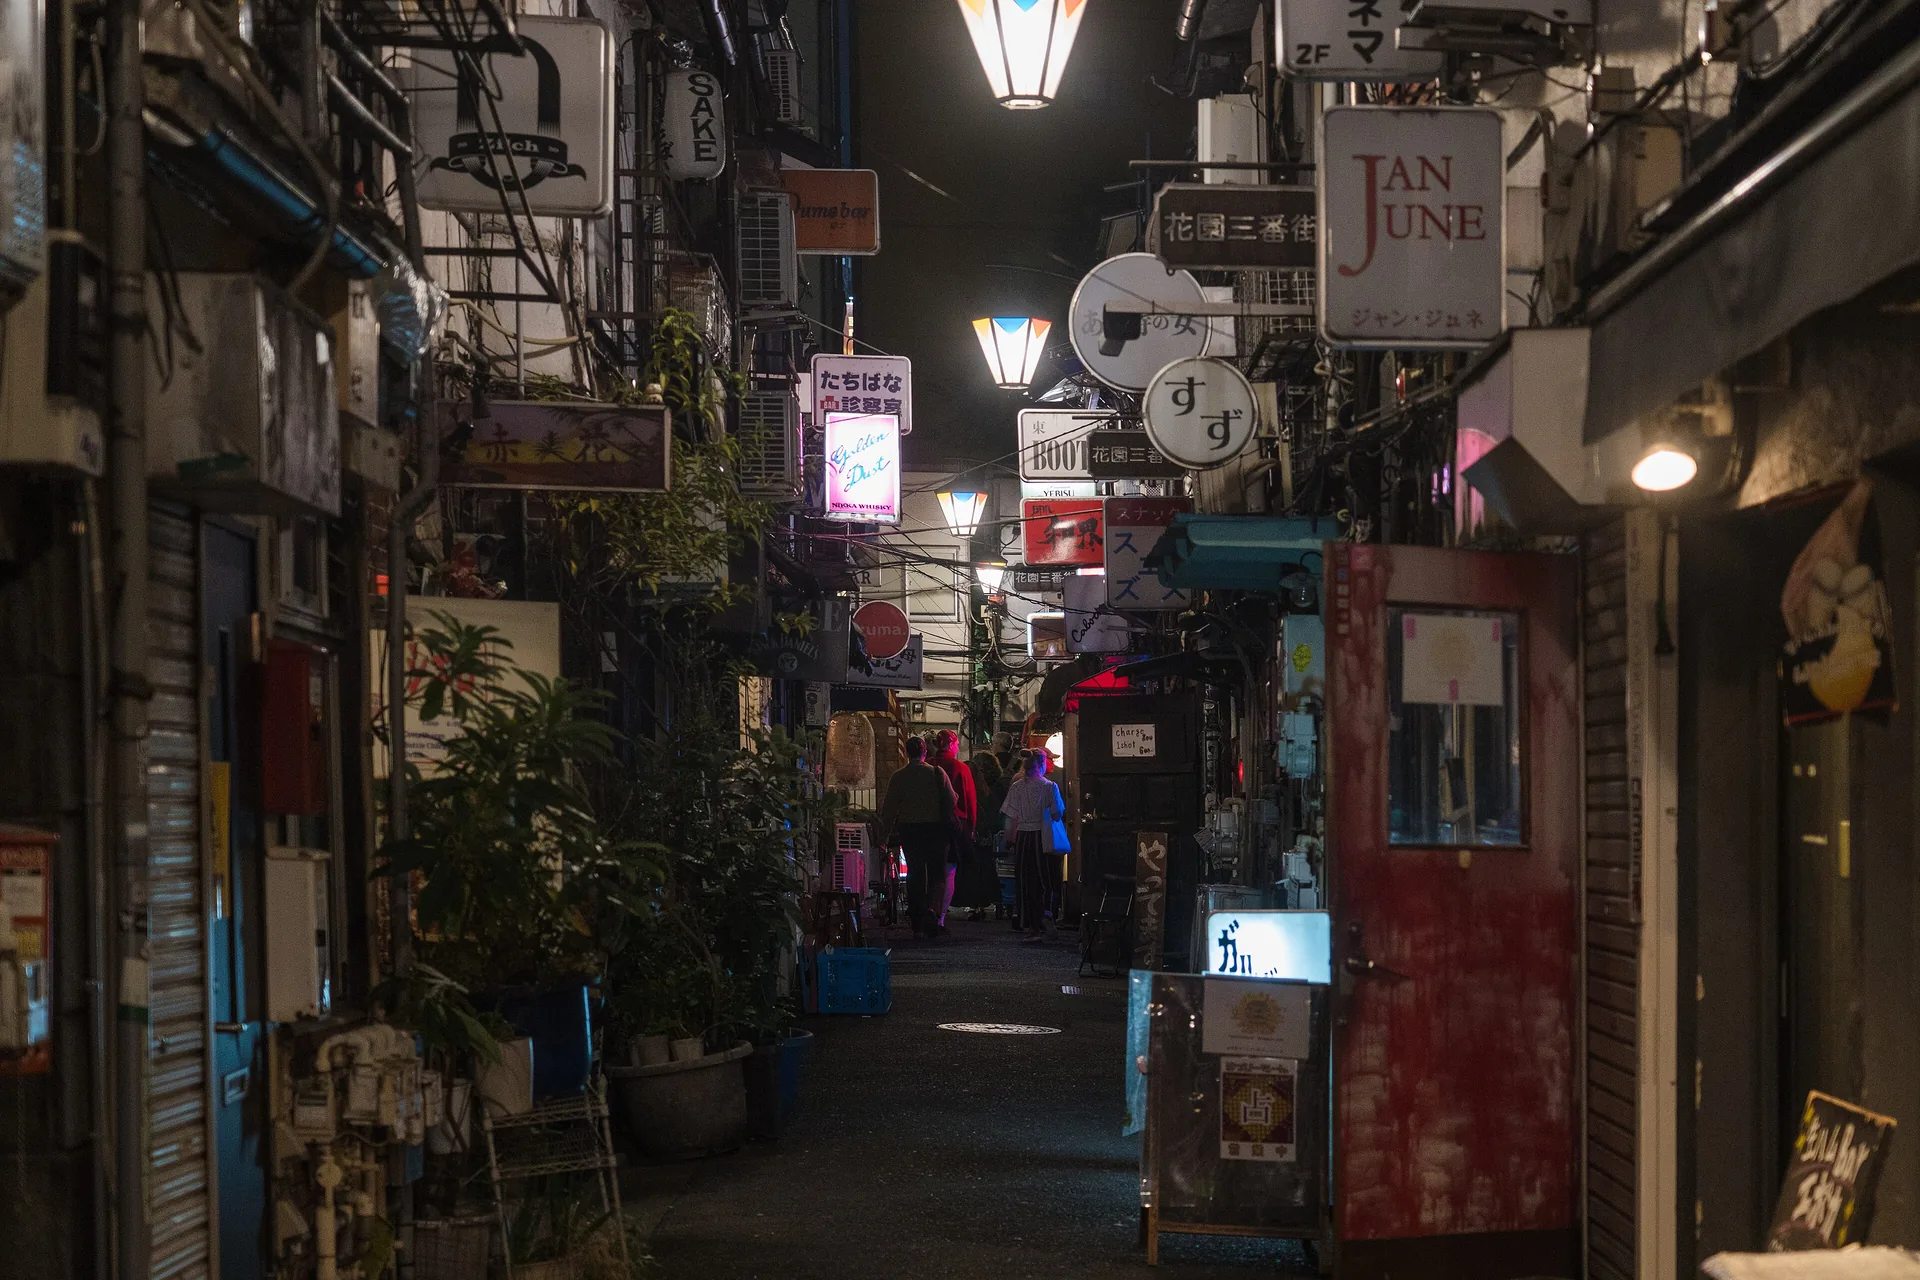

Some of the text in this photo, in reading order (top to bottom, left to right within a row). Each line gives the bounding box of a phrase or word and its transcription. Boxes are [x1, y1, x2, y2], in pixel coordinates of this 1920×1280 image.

[1296, 44, 1331, 65] 2F
[687, 73, 719, 162] SAKE
[1163, 211, 1317, 244] 花園三番街
[820, 370, 903, 393] たちばな
[1164, 376, 1243, 451] すず
[843, 455, 891, 493] Dust
[859, 503, 892, 511] WHISKY
